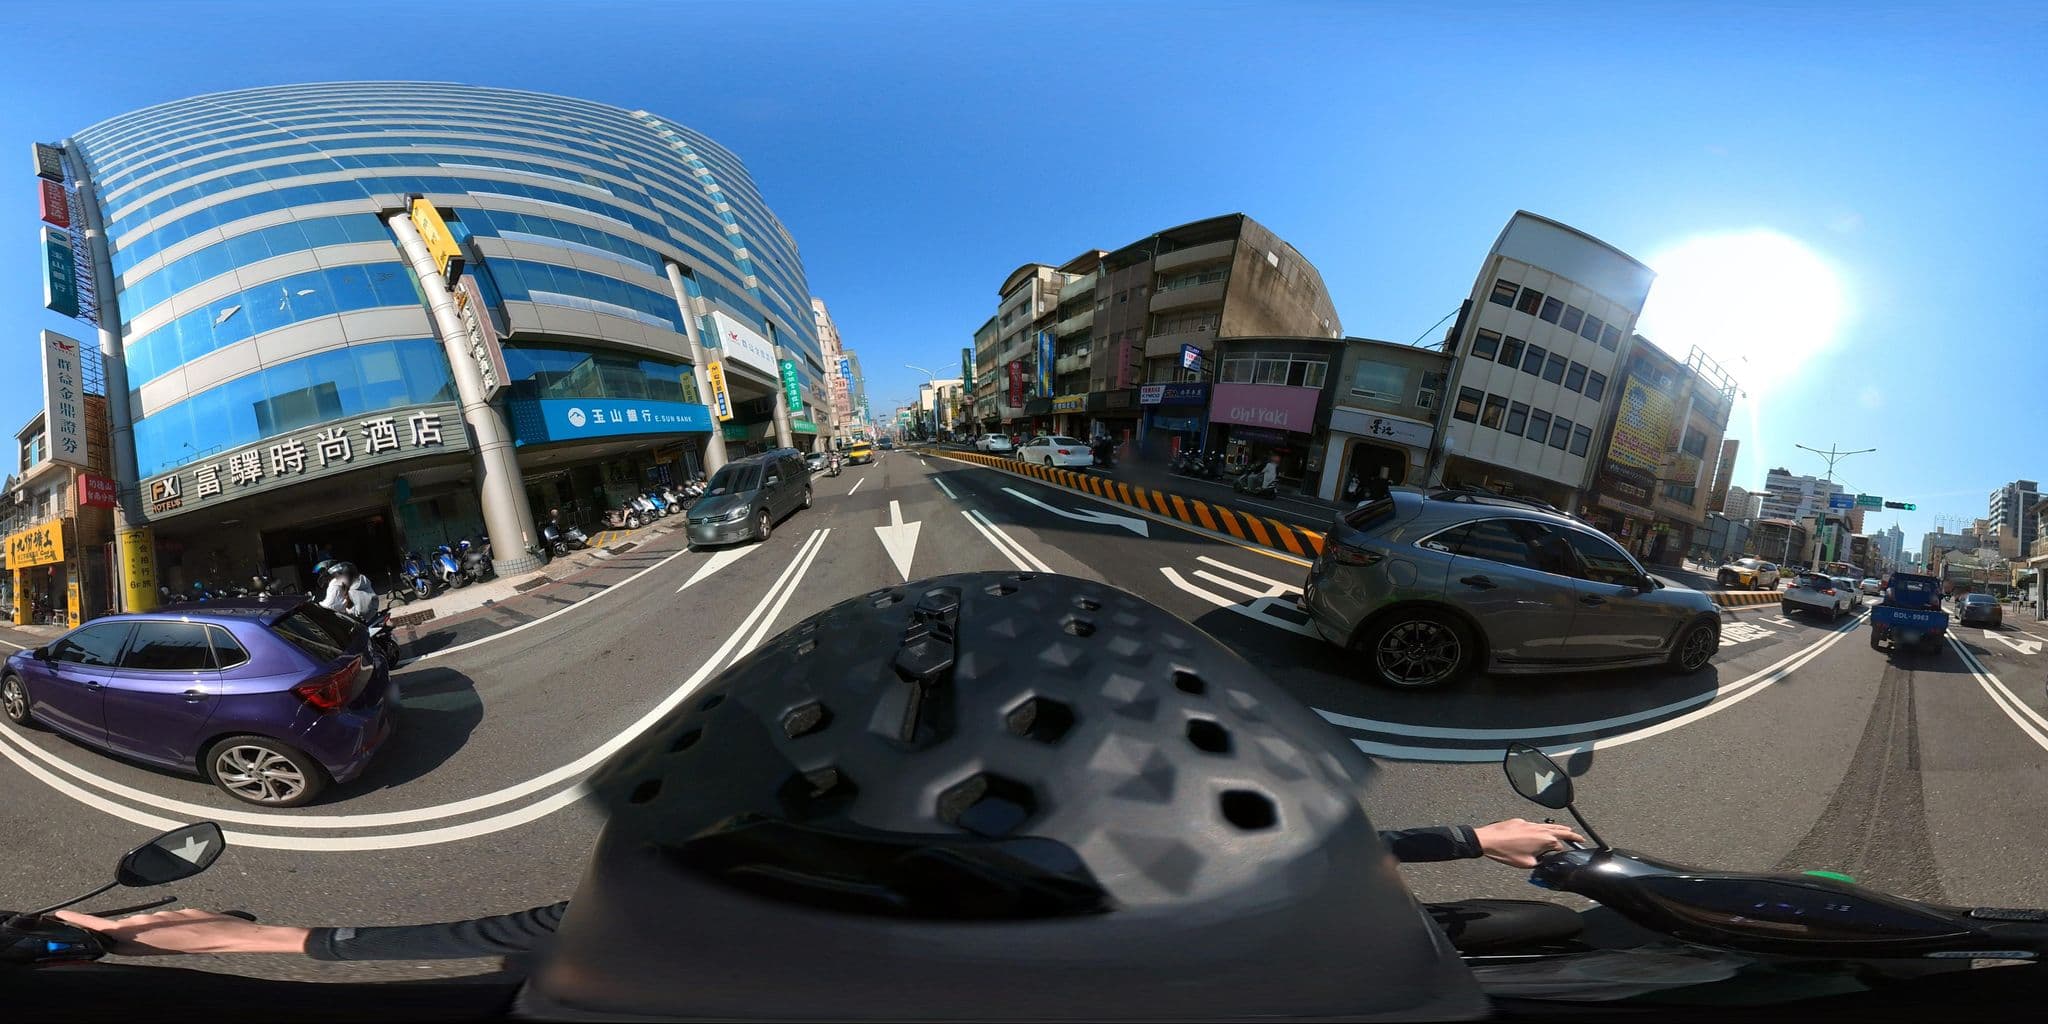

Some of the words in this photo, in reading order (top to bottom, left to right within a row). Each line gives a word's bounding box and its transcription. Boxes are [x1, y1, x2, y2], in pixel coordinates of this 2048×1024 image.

[57, 358, 78, 453] 群益金鼎證券
[592, 408, 652, 424] 玉山銀行
[193, 411, 443, 498] 富驛時尚酒店
[152, 477, 177, 500] FX
[152, 496, 182, 513] HOTELS
